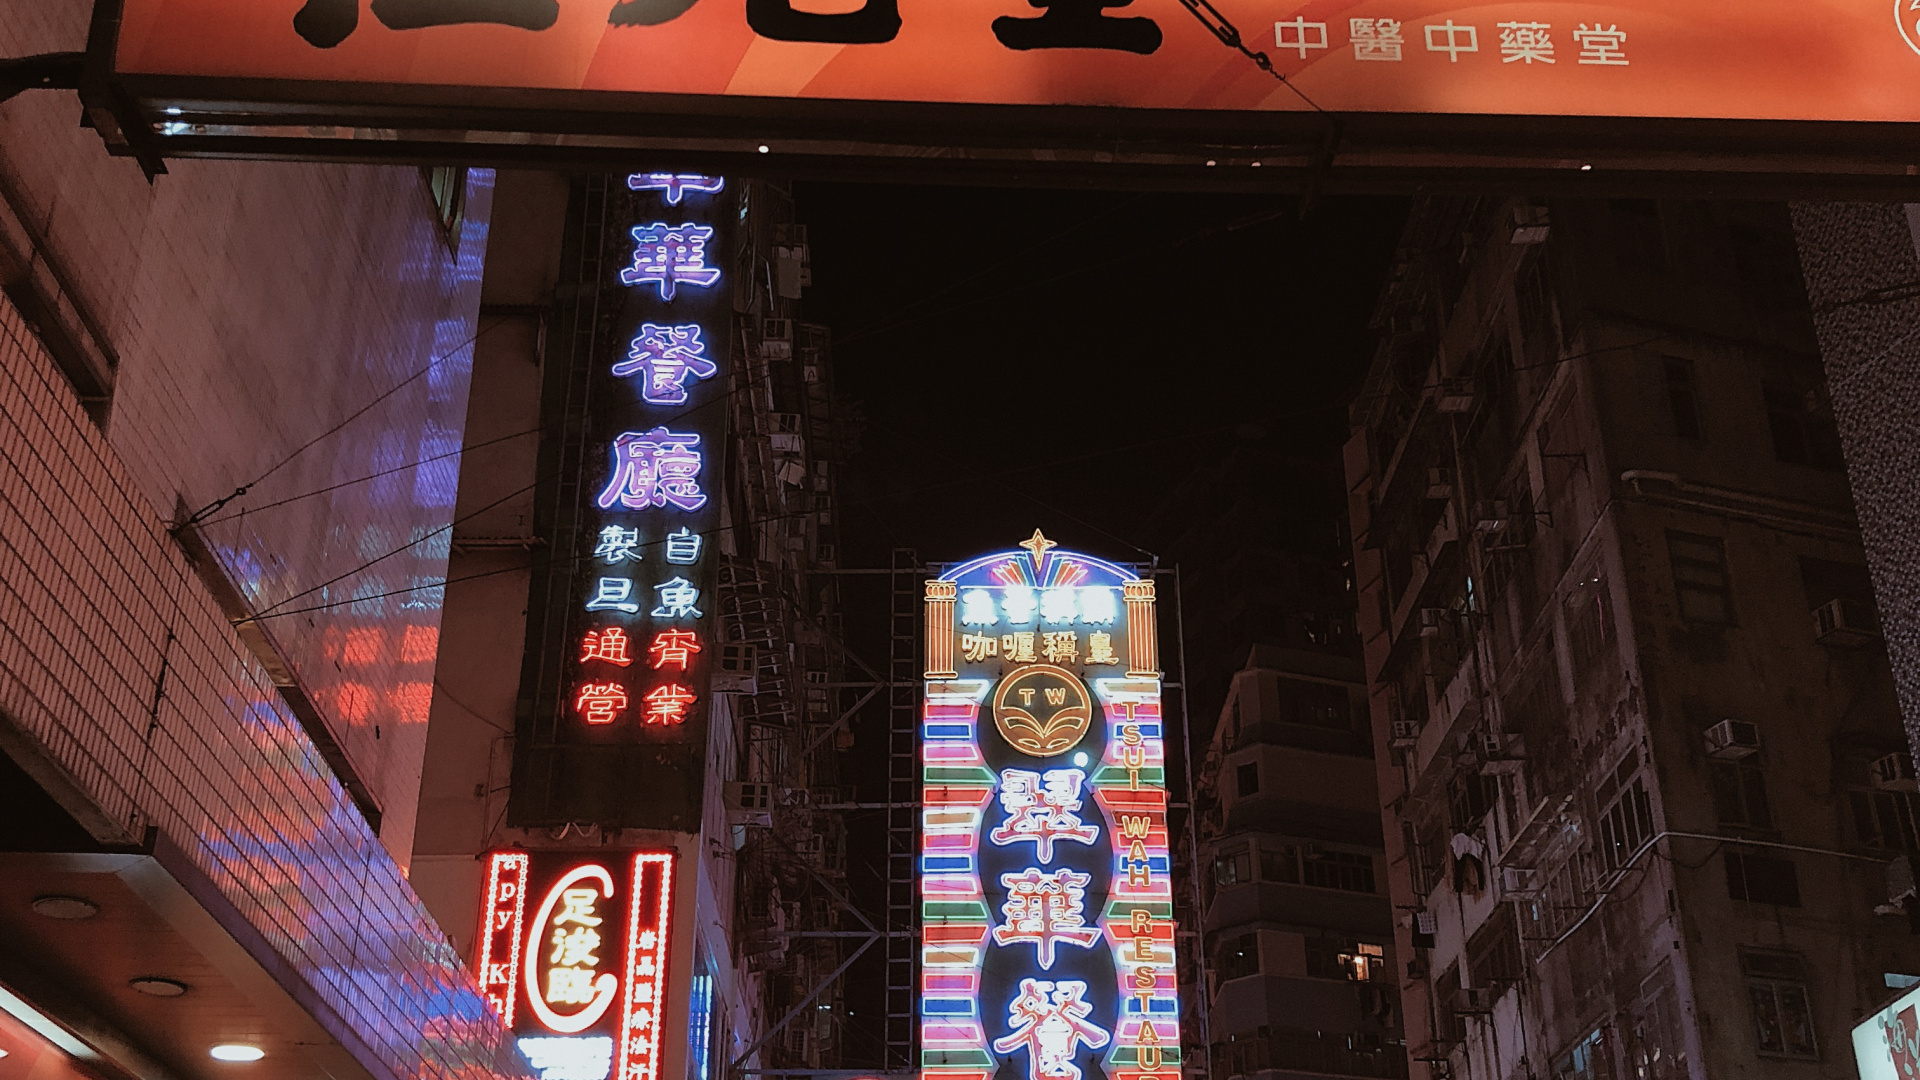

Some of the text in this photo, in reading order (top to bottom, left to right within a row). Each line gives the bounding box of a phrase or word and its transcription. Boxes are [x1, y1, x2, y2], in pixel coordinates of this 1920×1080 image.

[1274, 16, 1630, 66] 中醫中藥堂
[989, 768, 1110, 1080] 翠華餐
[1121, 701, 1162, 1080] TSUI WAH RESTAU
